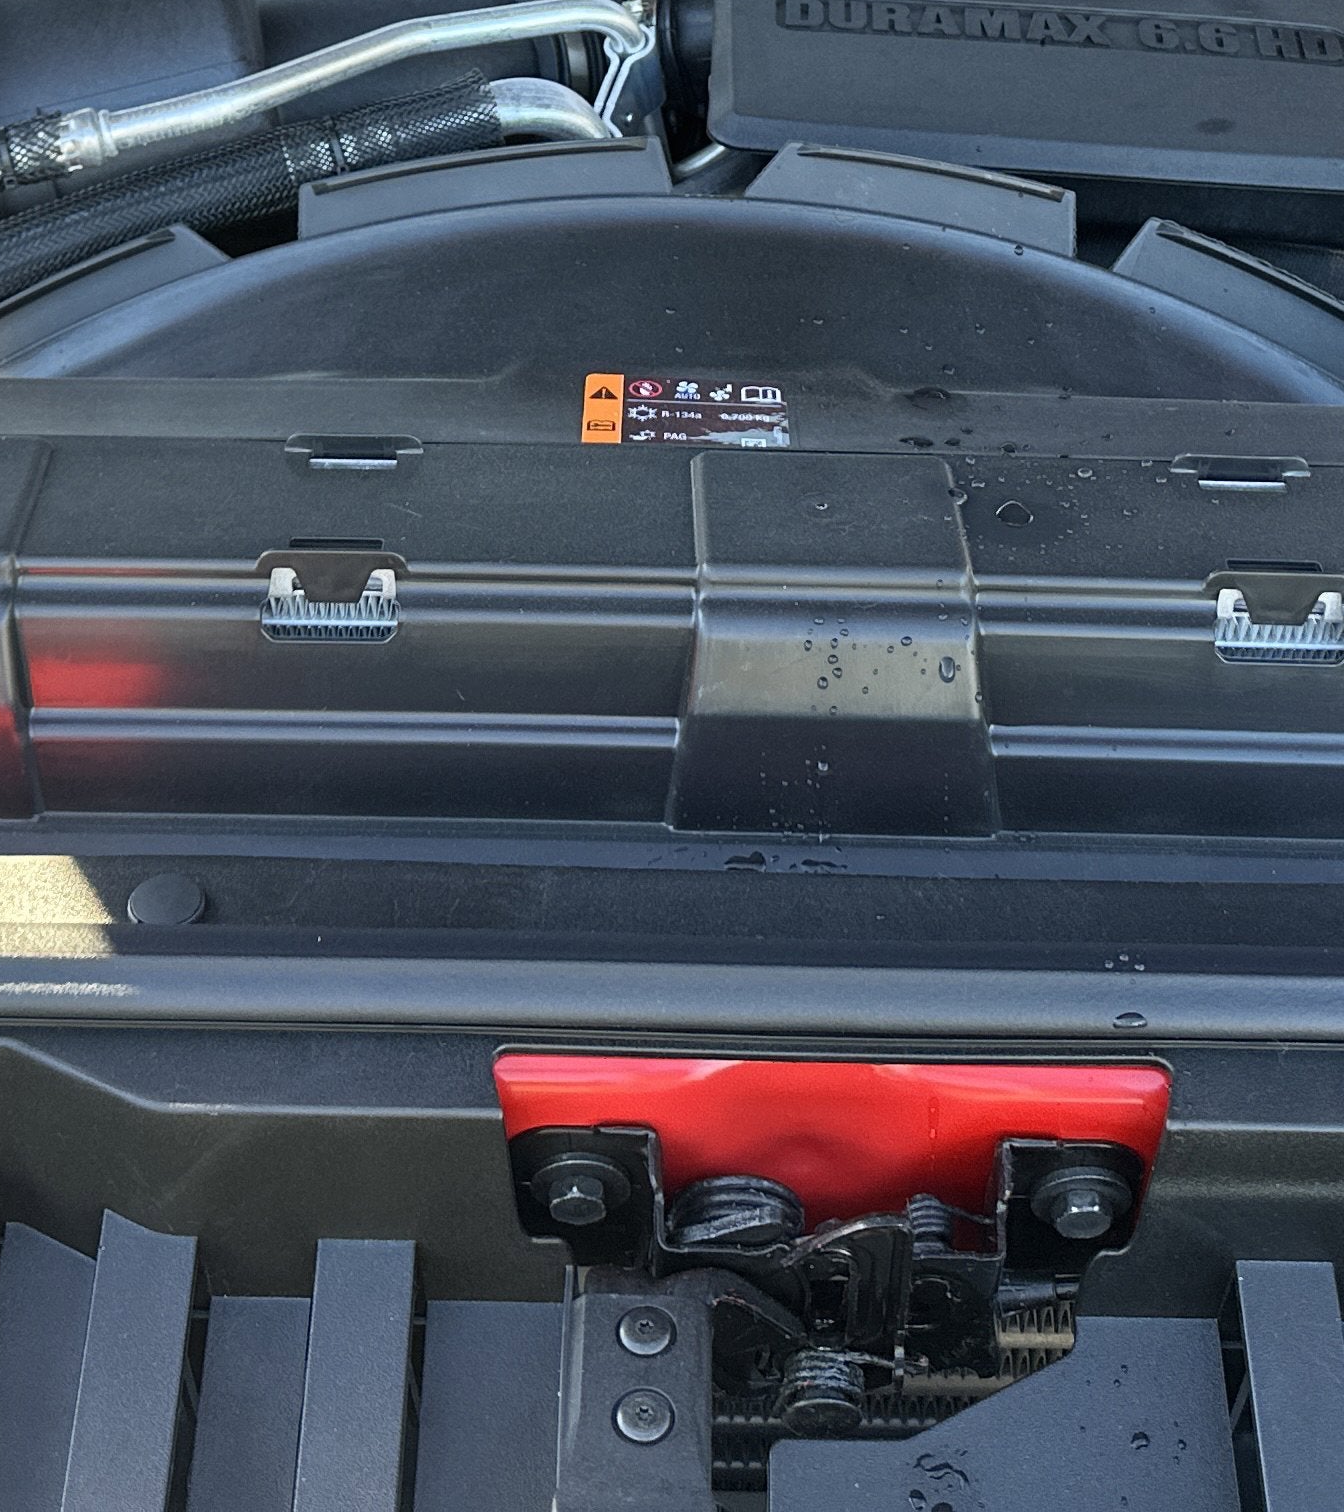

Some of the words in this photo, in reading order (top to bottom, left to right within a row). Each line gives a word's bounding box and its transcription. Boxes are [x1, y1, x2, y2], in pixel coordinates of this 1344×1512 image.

[1137, 17, 1240, 55] 6.6
[1256, 25, 1344, 62] HD
[674, 392, 701, 400] AUTO
[661, 410, 703, 420] R-134a
[663, 432, 688, 441] PAG
